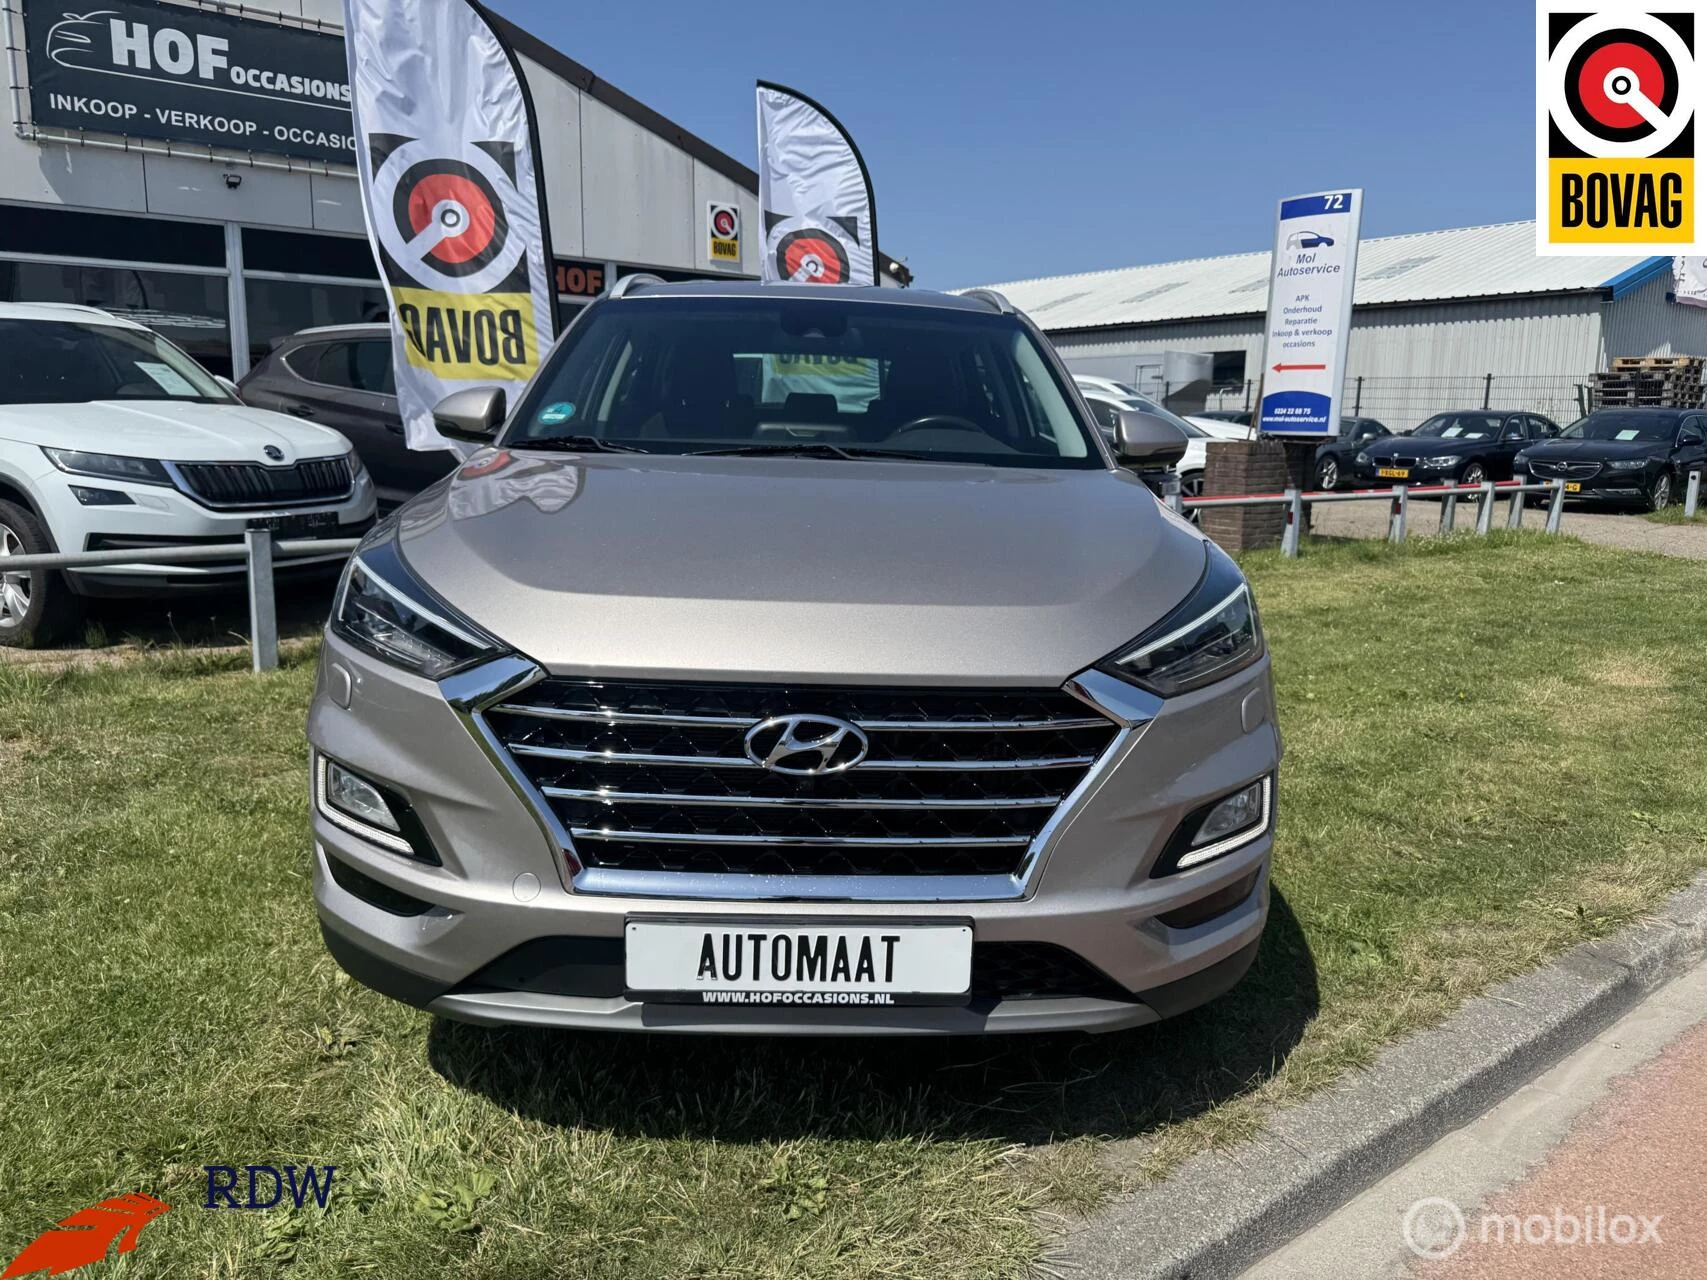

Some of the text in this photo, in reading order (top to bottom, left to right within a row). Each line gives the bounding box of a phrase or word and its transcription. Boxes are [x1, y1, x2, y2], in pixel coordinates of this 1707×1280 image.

[109, 18, 351, 102] HOF OCCASIONS
[49, 93, 137, 119] INKOOP
[155, 108, 257, 136] VERKOOP
[274, 126, 357, 151] OCCASIO
[1323, 194, 1343, 210] 72
[713, 241, 737, 257] BOVAG
[1296, 253, 1316, 264] Mol
[1277, 265, 1341, 278] Autoservice
[1295, 294, 1310, 302] APK
[1283, 305, 1322, 314] Onderhoud
[1284, 317, 1318, 326] Reparatie
[1294, 329, 1299, 337] &
[1301, 329, 1333, 337] verkoop
[697, 933, 901, 983] AUTOMAAT
[702, 991, 895, 1004] WWW.HOFOCCASIONS.NL
